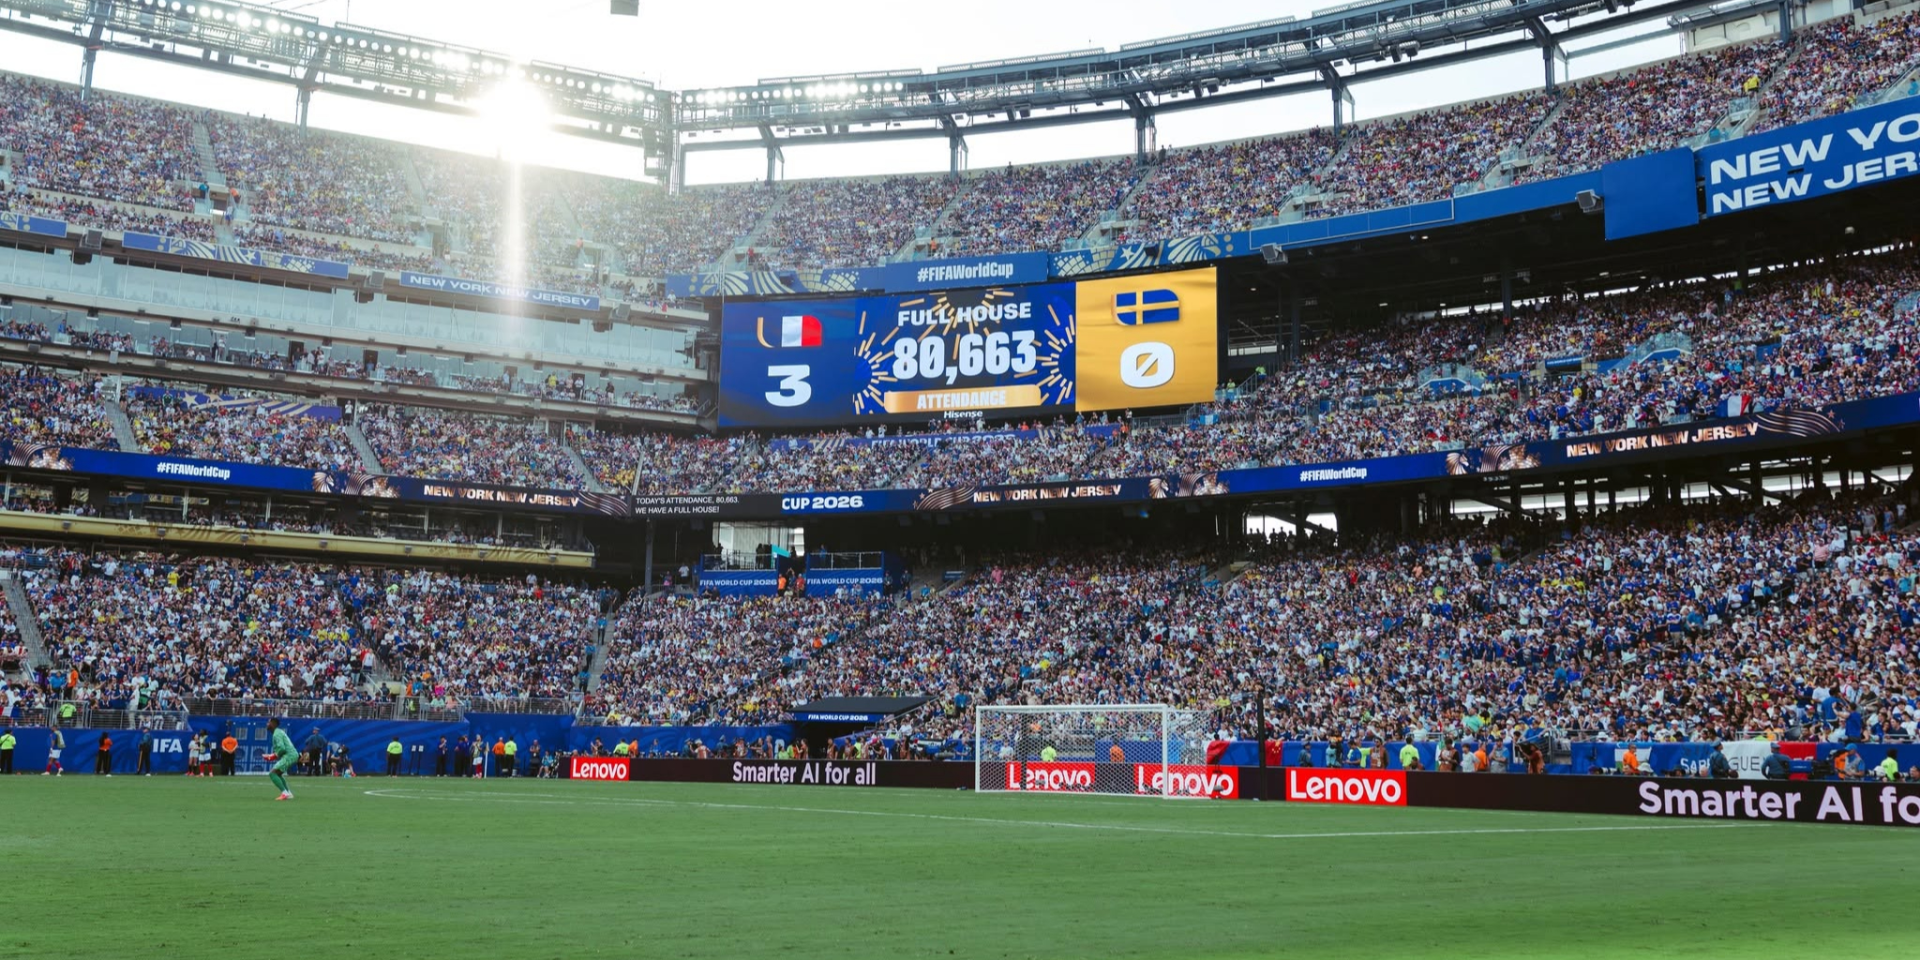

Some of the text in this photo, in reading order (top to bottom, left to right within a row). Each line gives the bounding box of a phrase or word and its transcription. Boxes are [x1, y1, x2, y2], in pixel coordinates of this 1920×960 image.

[1710, 112, 1920, 185] NEW YO
[1712, 151, 1920, 214] NEW JER
[917, 262, 1014, 283] #FIFAWorldCup
[410, 275, 591, 307] NEW YORK NEW JERSEY
[898, 302, 1032, 327] FULL HOUSE
[893, 330, 1038, 385] 80,663
[765, 364, 813, 407] 3
[916, 390, 1007, 411] ATTENDANCE
[944, 410, 984, 419] Hisense
[1566, 422, 1759, 458] NEW YORK NEW JERSEY
[157, 462, 231, 480] #FIFAWorldCup
[1300, 466, 1367, 482] #FIFAWorldCup
[424, 484, 579, 507] NEW YORK NEW JERSEY
[636, 497, 665, 505] TODAY'S
[781, 495, 863, 510] CUP 2026
[973, 484, 1122, 503] NEW YORK NEW JERSEY
[674, 506, 691, 514] FULL
[753, 578, 777, 586] 2026
[807, 577, 821, 585] FIFA
[821, 577, 845, 585] WORLD
[152, 738, 183, 753] IFA
[572, 757, 627, 780] Lenovo
[732, 761, 876, 785] Smarter AI for all
[1009, 763, 1091, 790] Lenovo
[1138, 765, 1234, 796] Lenovo
[1290, 770, 1401, 803] Lenovo
[1638, 781, 1920, 824] Smarter AI fo
